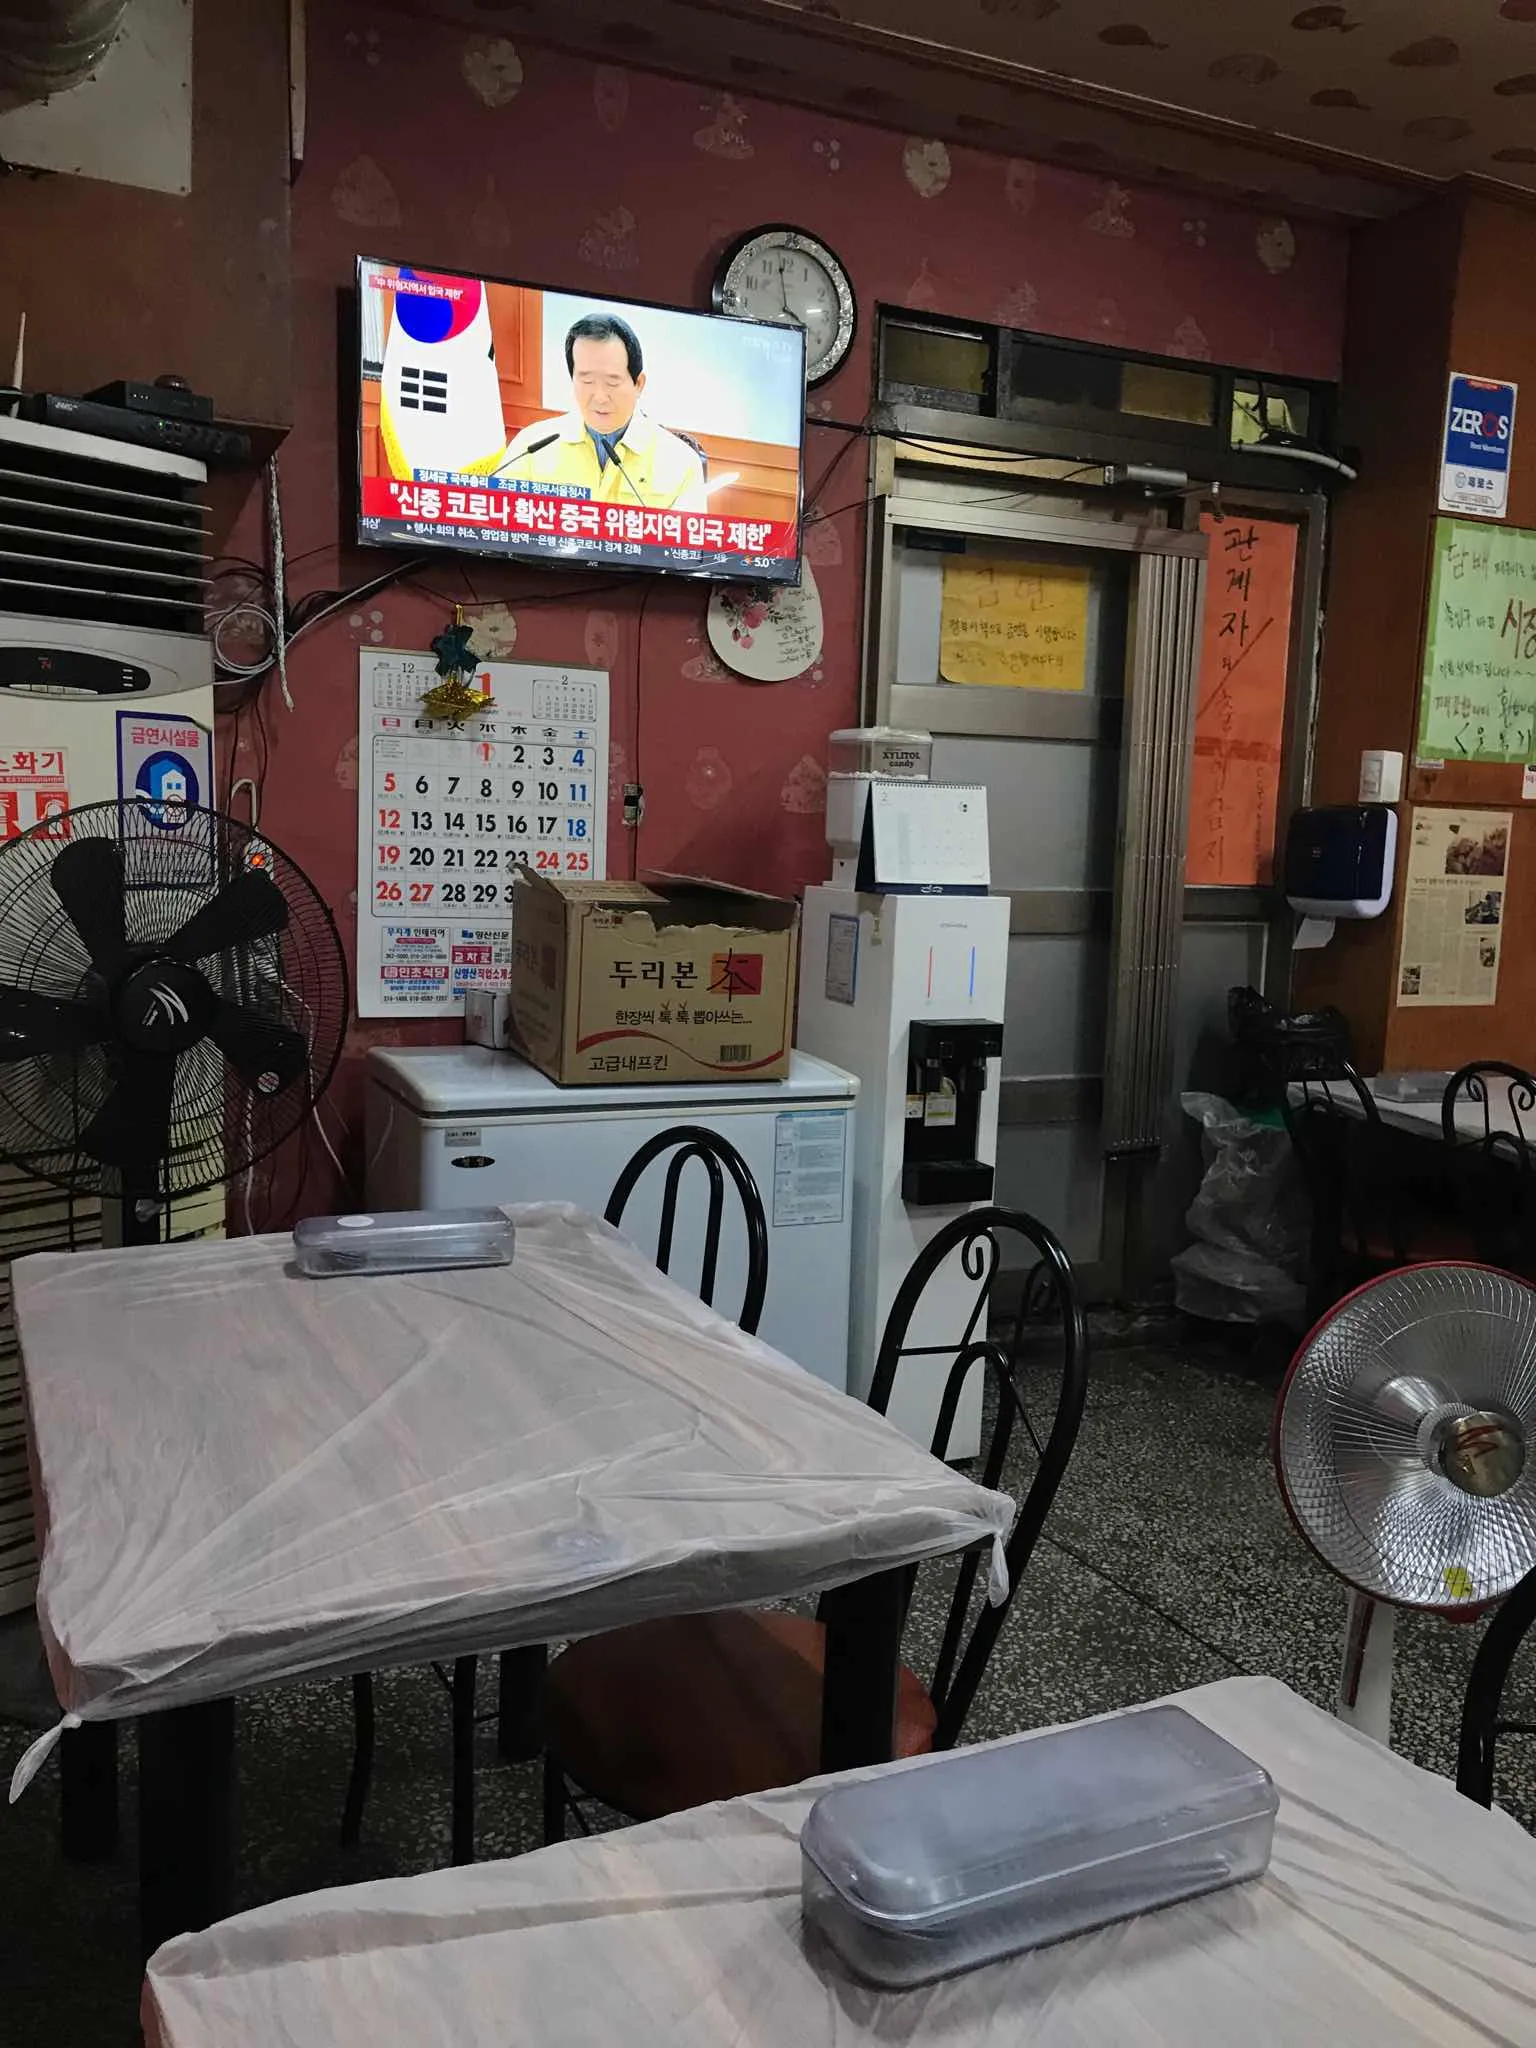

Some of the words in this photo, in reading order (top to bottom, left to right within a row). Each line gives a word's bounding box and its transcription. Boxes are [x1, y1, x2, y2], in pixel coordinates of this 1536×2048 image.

[762, 260, 773, 275] 11
[387, 278, 427, 294] 위험지역서
[428, 284, 444, 297] 입국
[1450, 407, 1509, 440] ZEROS
[419, 470, 448, 484] 정세균
[450, 475, 489, 489] 국무총리
[498, 478, 518, 492] 조금
[519, 480, 530, 493] 전
[531, 483, 587, 499] 정부서울청사
[389, 482, 441, 519] "신종
[445, 493, 510, 526] 코로나
[514, 498, 556, 530] 확산
[560, 503, 601, 536] 중국
[604, 507, 681, 543] 위험지역
[686, 517, 725, 549] 입국
[727, 522, 773, 552] 제한"
[457, 525, 479, 541] 취소,
[481, 529, 509, 543] 영업점
[604, 541, 623, 554] 경계
[624, 543, 642, 556] 강화
[1447, 543, 1490, 582] 담배
[1217, 524, 1259, 649] 관계자
[401, 662, 415, 673] 12
[561, 675, 569, 686] 2
[131, 727, 200, 748] 금연시설물
[382, 717, 401, 728] 日
[415, 719, 434, 729] 月
[447, 721, 465, 732] 火
[479, 722, 496, 733] 水
[511, 725, 527, 735] 木
[542, 727, 559, 738] 金
[574, 729, 589, 740] 土
[513, 745, 525, 763] 2
[543, 747, 554, 766] 3
[572, 749, 585, 767] 4
[882, 751, 921, 760] XYLITOL
[889, 759, 914, 768] candy
[383, 772, 396, 793] 5
[415, 775, 429, 794] 6
[448, 776, 460, 795] 7
[480, 778, 492, 798] 8
[511, 780, 525, 799] 9
[538, 782, 559, 801] 10
[569, 783, 587, 802] 11
[378, 808, 401, 829] 12
[411, 811, 433, 830] 13
[444, 812, 465, 831] 14
[475, 813, 497, 833] 15
[507, 815, 528, 834] 16
[537, 816, 557, 834] 17
[567, 818, 586, 837] 18
[377, 845, 401, 865] 19
[409, 847, 435, 866] 20
[443, 848, 464, 867] 21
[473, 849, 498, 868] 22
[535, 850, 560, 869] 24
[566, 852, 589, 871] 25
[375, 880, 402, 900] 26
[409, 883, 434, 903] 27
[441, 884, 466, 903] 28
[472, 884, 498, 903] 29
[609, 960, 698, 989] 두리본
[615, 1009, 654, 1026] 한장씩
[588, 1054, 668, 1072] 고급내프킨
